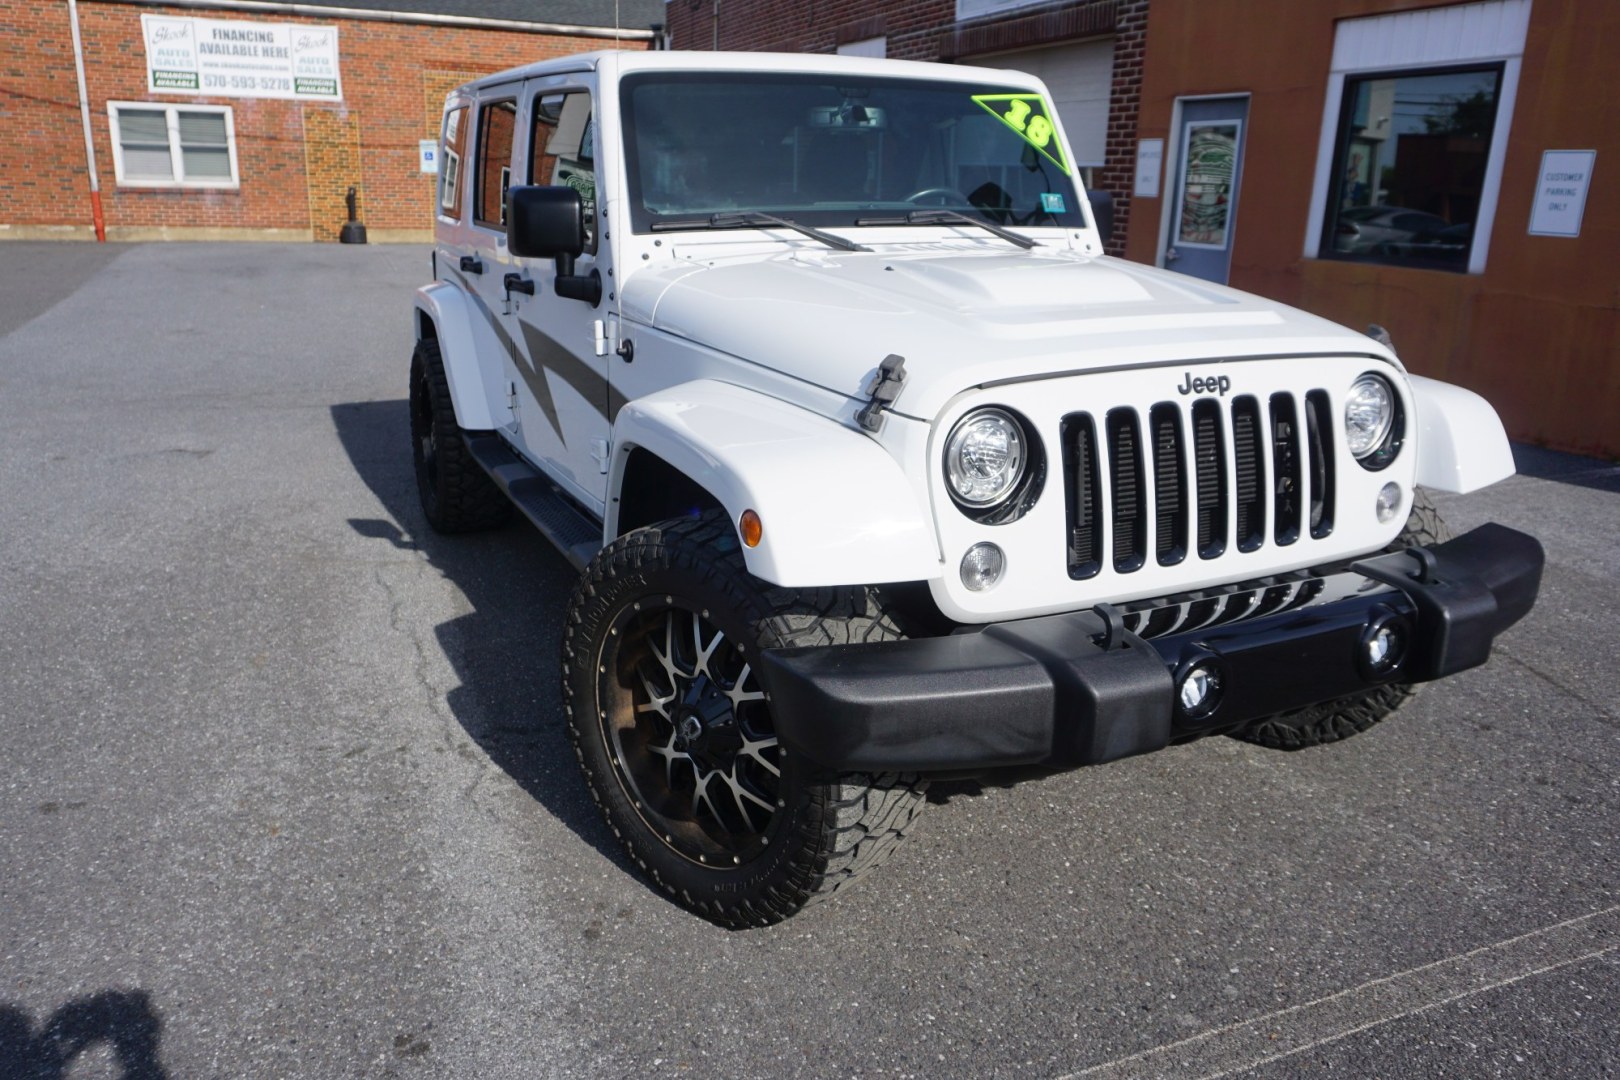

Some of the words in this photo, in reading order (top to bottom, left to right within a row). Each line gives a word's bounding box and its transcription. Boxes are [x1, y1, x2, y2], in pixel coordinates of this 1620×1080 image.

[212, 28, 274, 43] FINANCING
[157, 47, 190, 58] AUTO
[199, 42, 259, 57] AVAILABLE
[262, 46, 289, 59] HERE
[155, 57, 194, 68] SALES
[299, 56, 330, 66] AUTO
[297, 64, 332, 75] SALES
[155, 71, 196, 81] FINANCING
[156, 79, 196, 87] AVAILABLE
[204, 74, 290, 90] 570-593-5278
[296, 78, 335, 87] FINANCING
[297, 86, 335, 95] AVAILABLE
[1004, 98, 1052, 147] 18
[1545, 173, 1584, 182] CUSTOMER
[1545, 188, 1577, 196] PARKING
[1548, 202, 1567, 211] ONLY
[1177, 372, 1231, 396] Jeep
